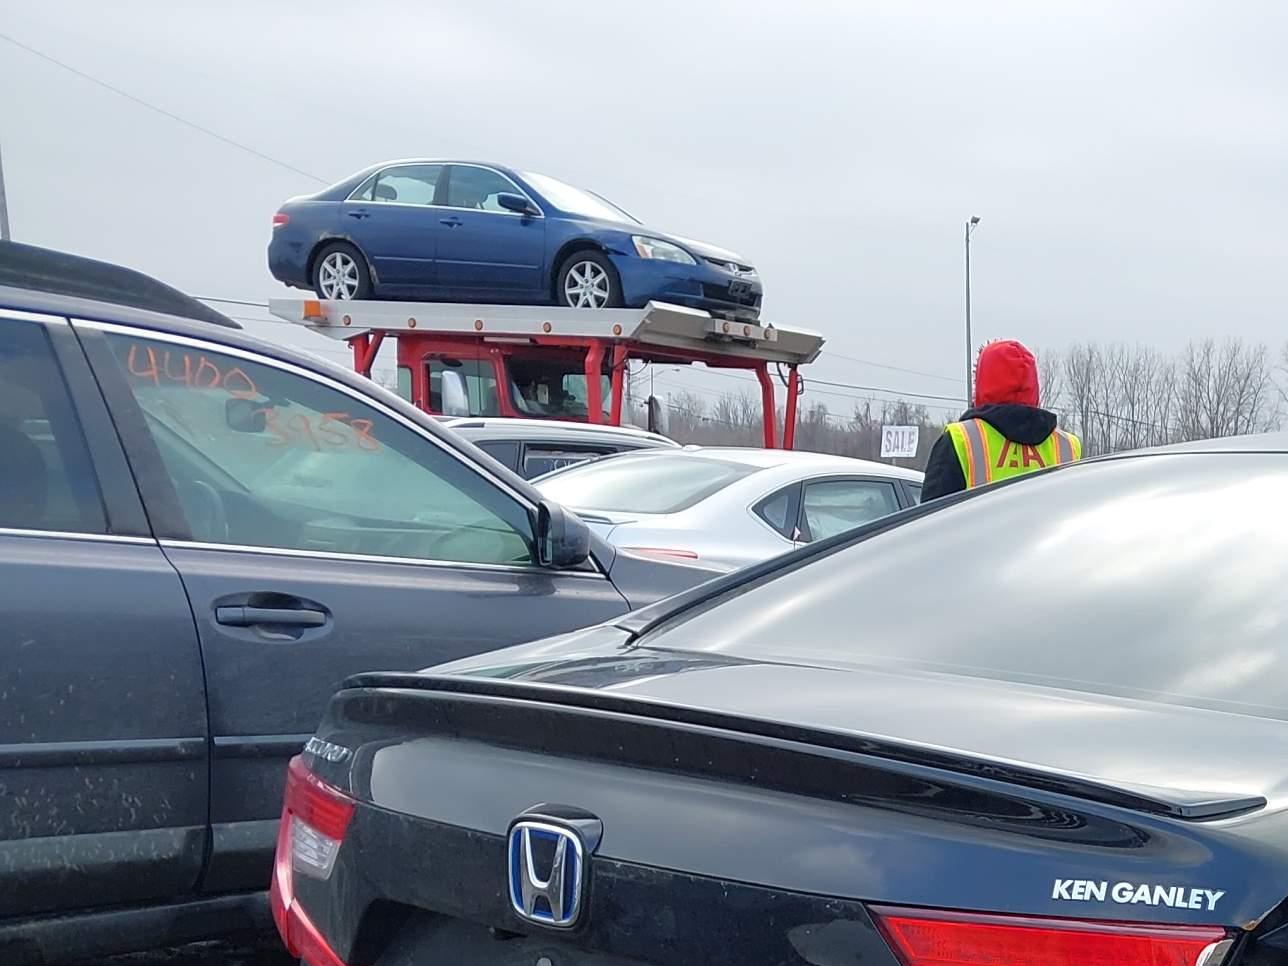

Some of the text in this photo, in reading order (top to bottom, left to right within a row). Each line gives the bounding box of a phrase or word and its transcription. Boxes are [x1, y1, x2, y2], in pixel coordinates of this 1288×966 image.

[884, 430, 916, 453] SALE
[1052, 879, 1226, 911] KEN GANLEY
